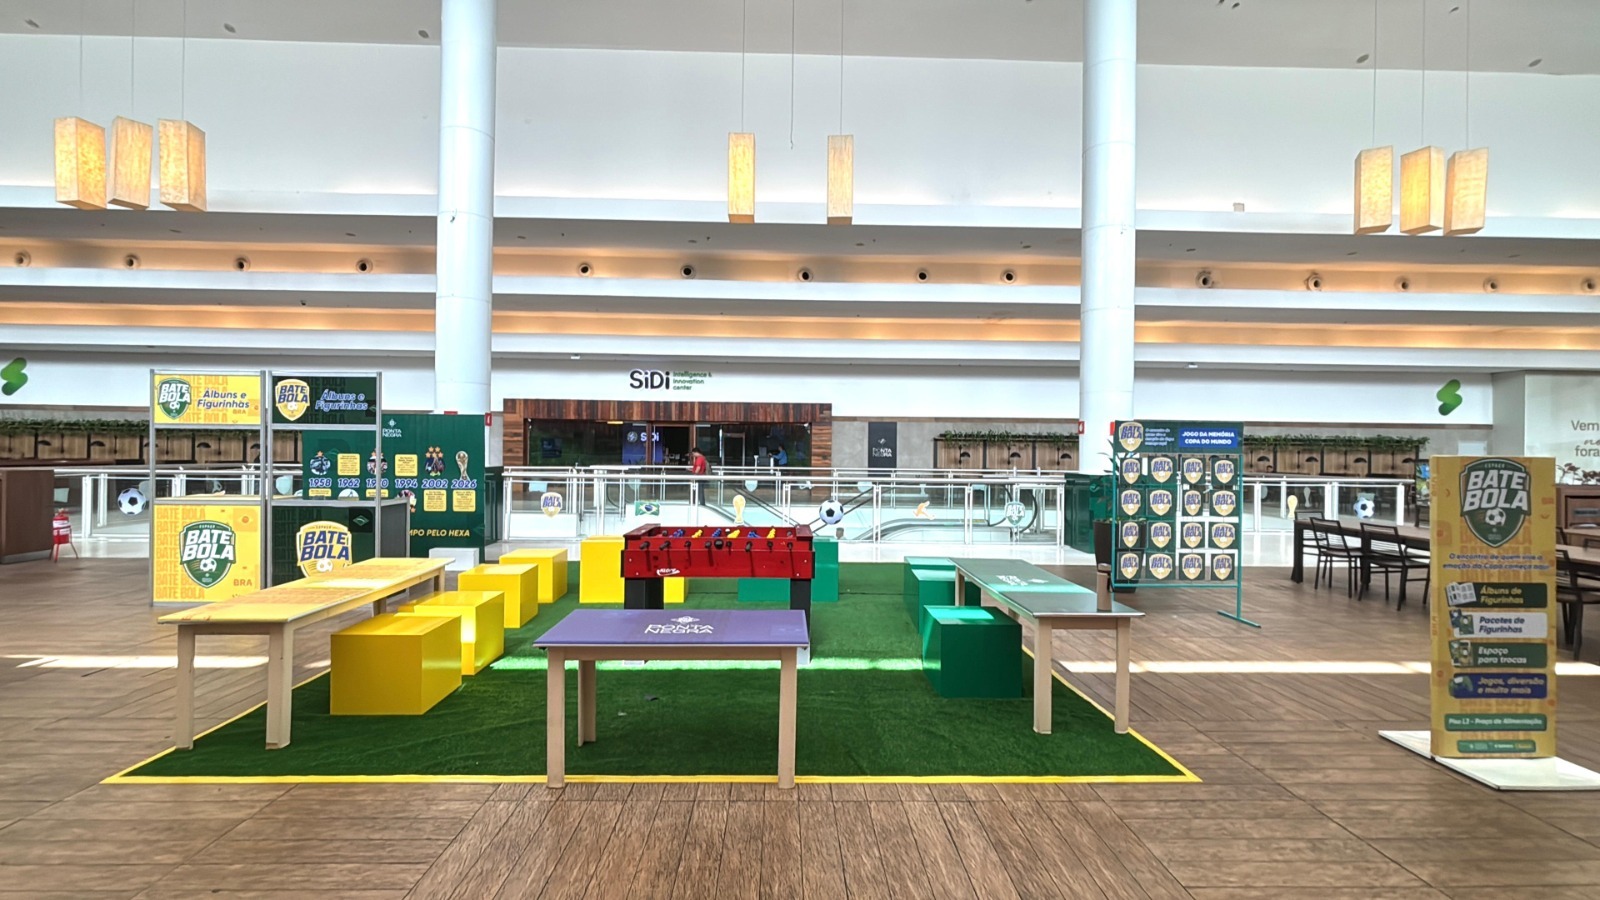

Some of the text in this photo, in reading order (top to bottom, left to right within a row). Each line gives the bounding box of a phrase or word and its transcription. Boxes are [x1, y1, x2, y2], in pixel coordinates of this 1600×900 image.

[630, 370, 670, 390] SiDi
[161, 384, 190, 393] BATE
[203, 388, 238, 398] Álbuns
[280, 385, 307, 394] BATE
[158, 392, 190, 404] BOLA
[278, 394, 308, 404] BOLA
[321, 388, 365, 401] Álbuns e
[197, 399, 250, 409] Figurinhas
[315, 400, 368, 412] Figurinhas
[1571, 420, 1600, 431] Vem
[308, 478, 478, 488] 1958 1962 190 1994 2002 2026
[1467, 470, 1526, 490] BATE
[1463, 488, 1528, 512] BOLA
[186, 530, 232, 545] BATE
[303, 530, 348, 546] BATE
[182, 544, 234, 562] BOLA
[300, 544, 349, 562] BOLA
[1480, 586, 1508, 594] Álbuns
[1479, 626, 1522, 634] Figurinhas
[1478, 647, 1508, 656] Espaço
